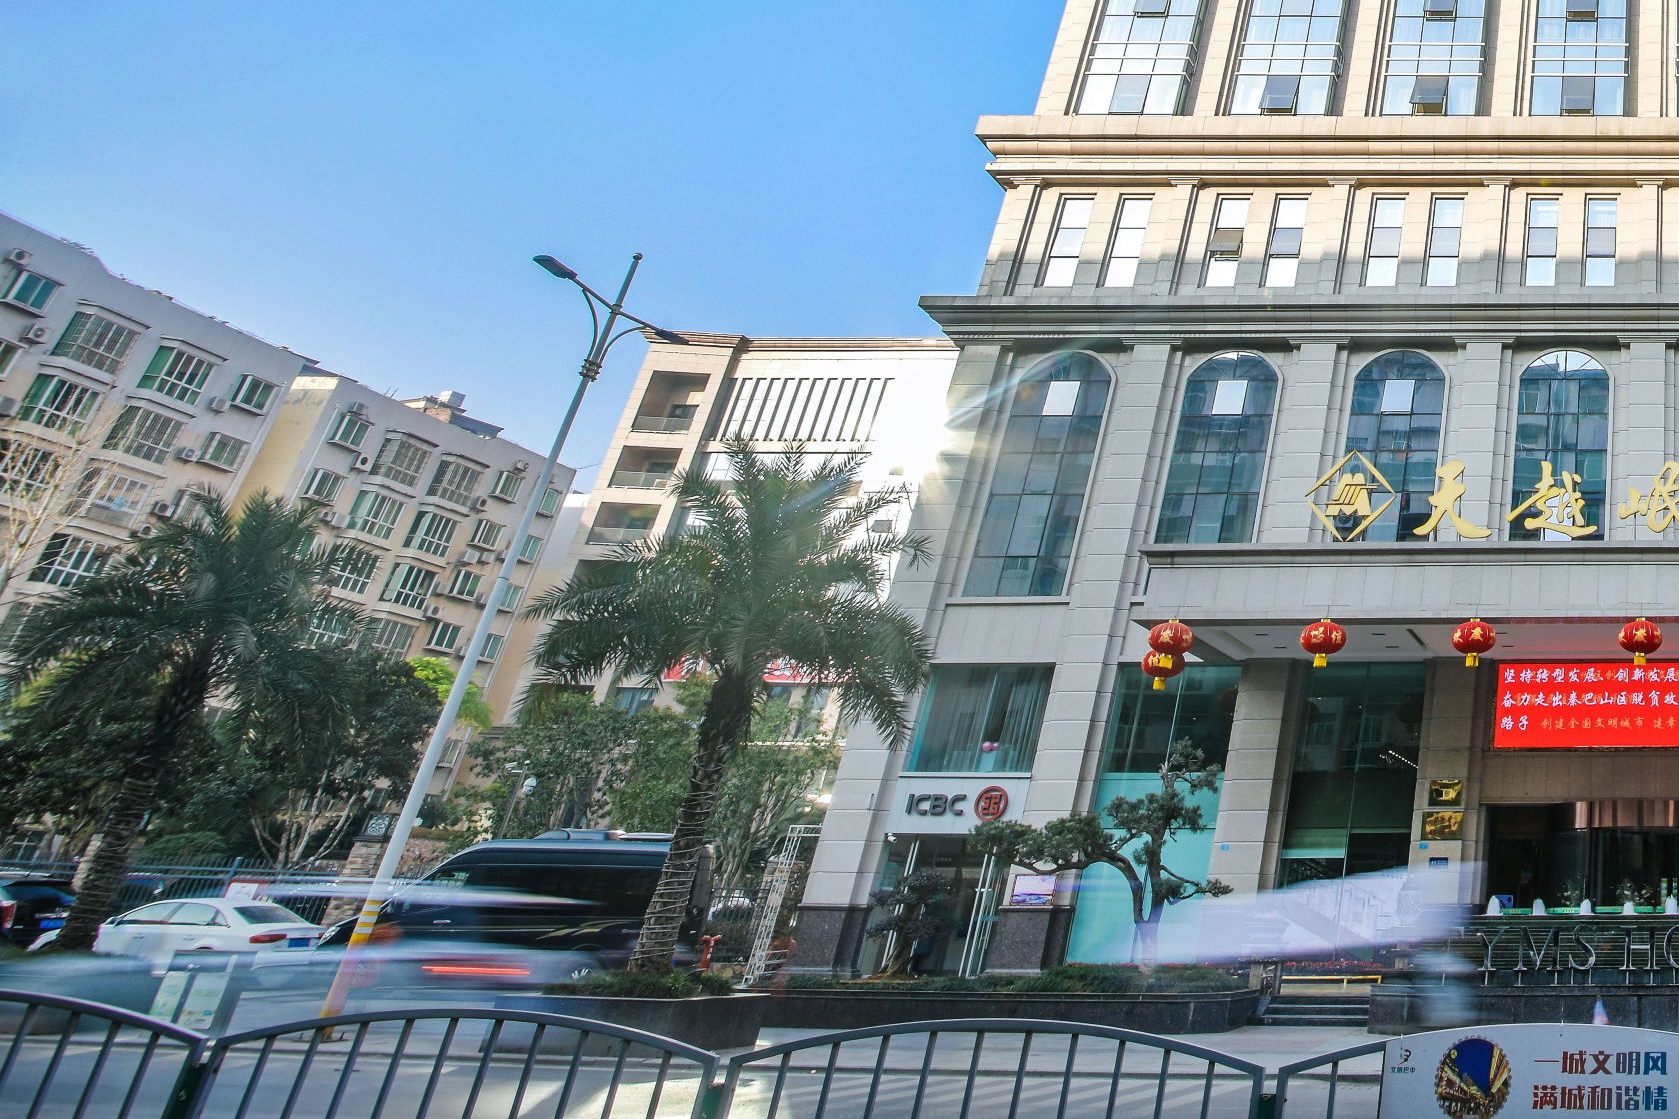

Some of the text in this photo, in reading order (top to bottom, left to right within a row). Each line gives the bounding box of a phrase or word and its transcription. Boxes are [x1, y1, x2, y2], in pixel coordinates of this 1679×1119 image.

[1500, 715, 1529, 730] 路子
[905, 793, 966, 816] ICBC
[1534, 1050, 1667, 1075] 一城文明风
[1532, 1084, 1667, 1110] 满城和谐情
